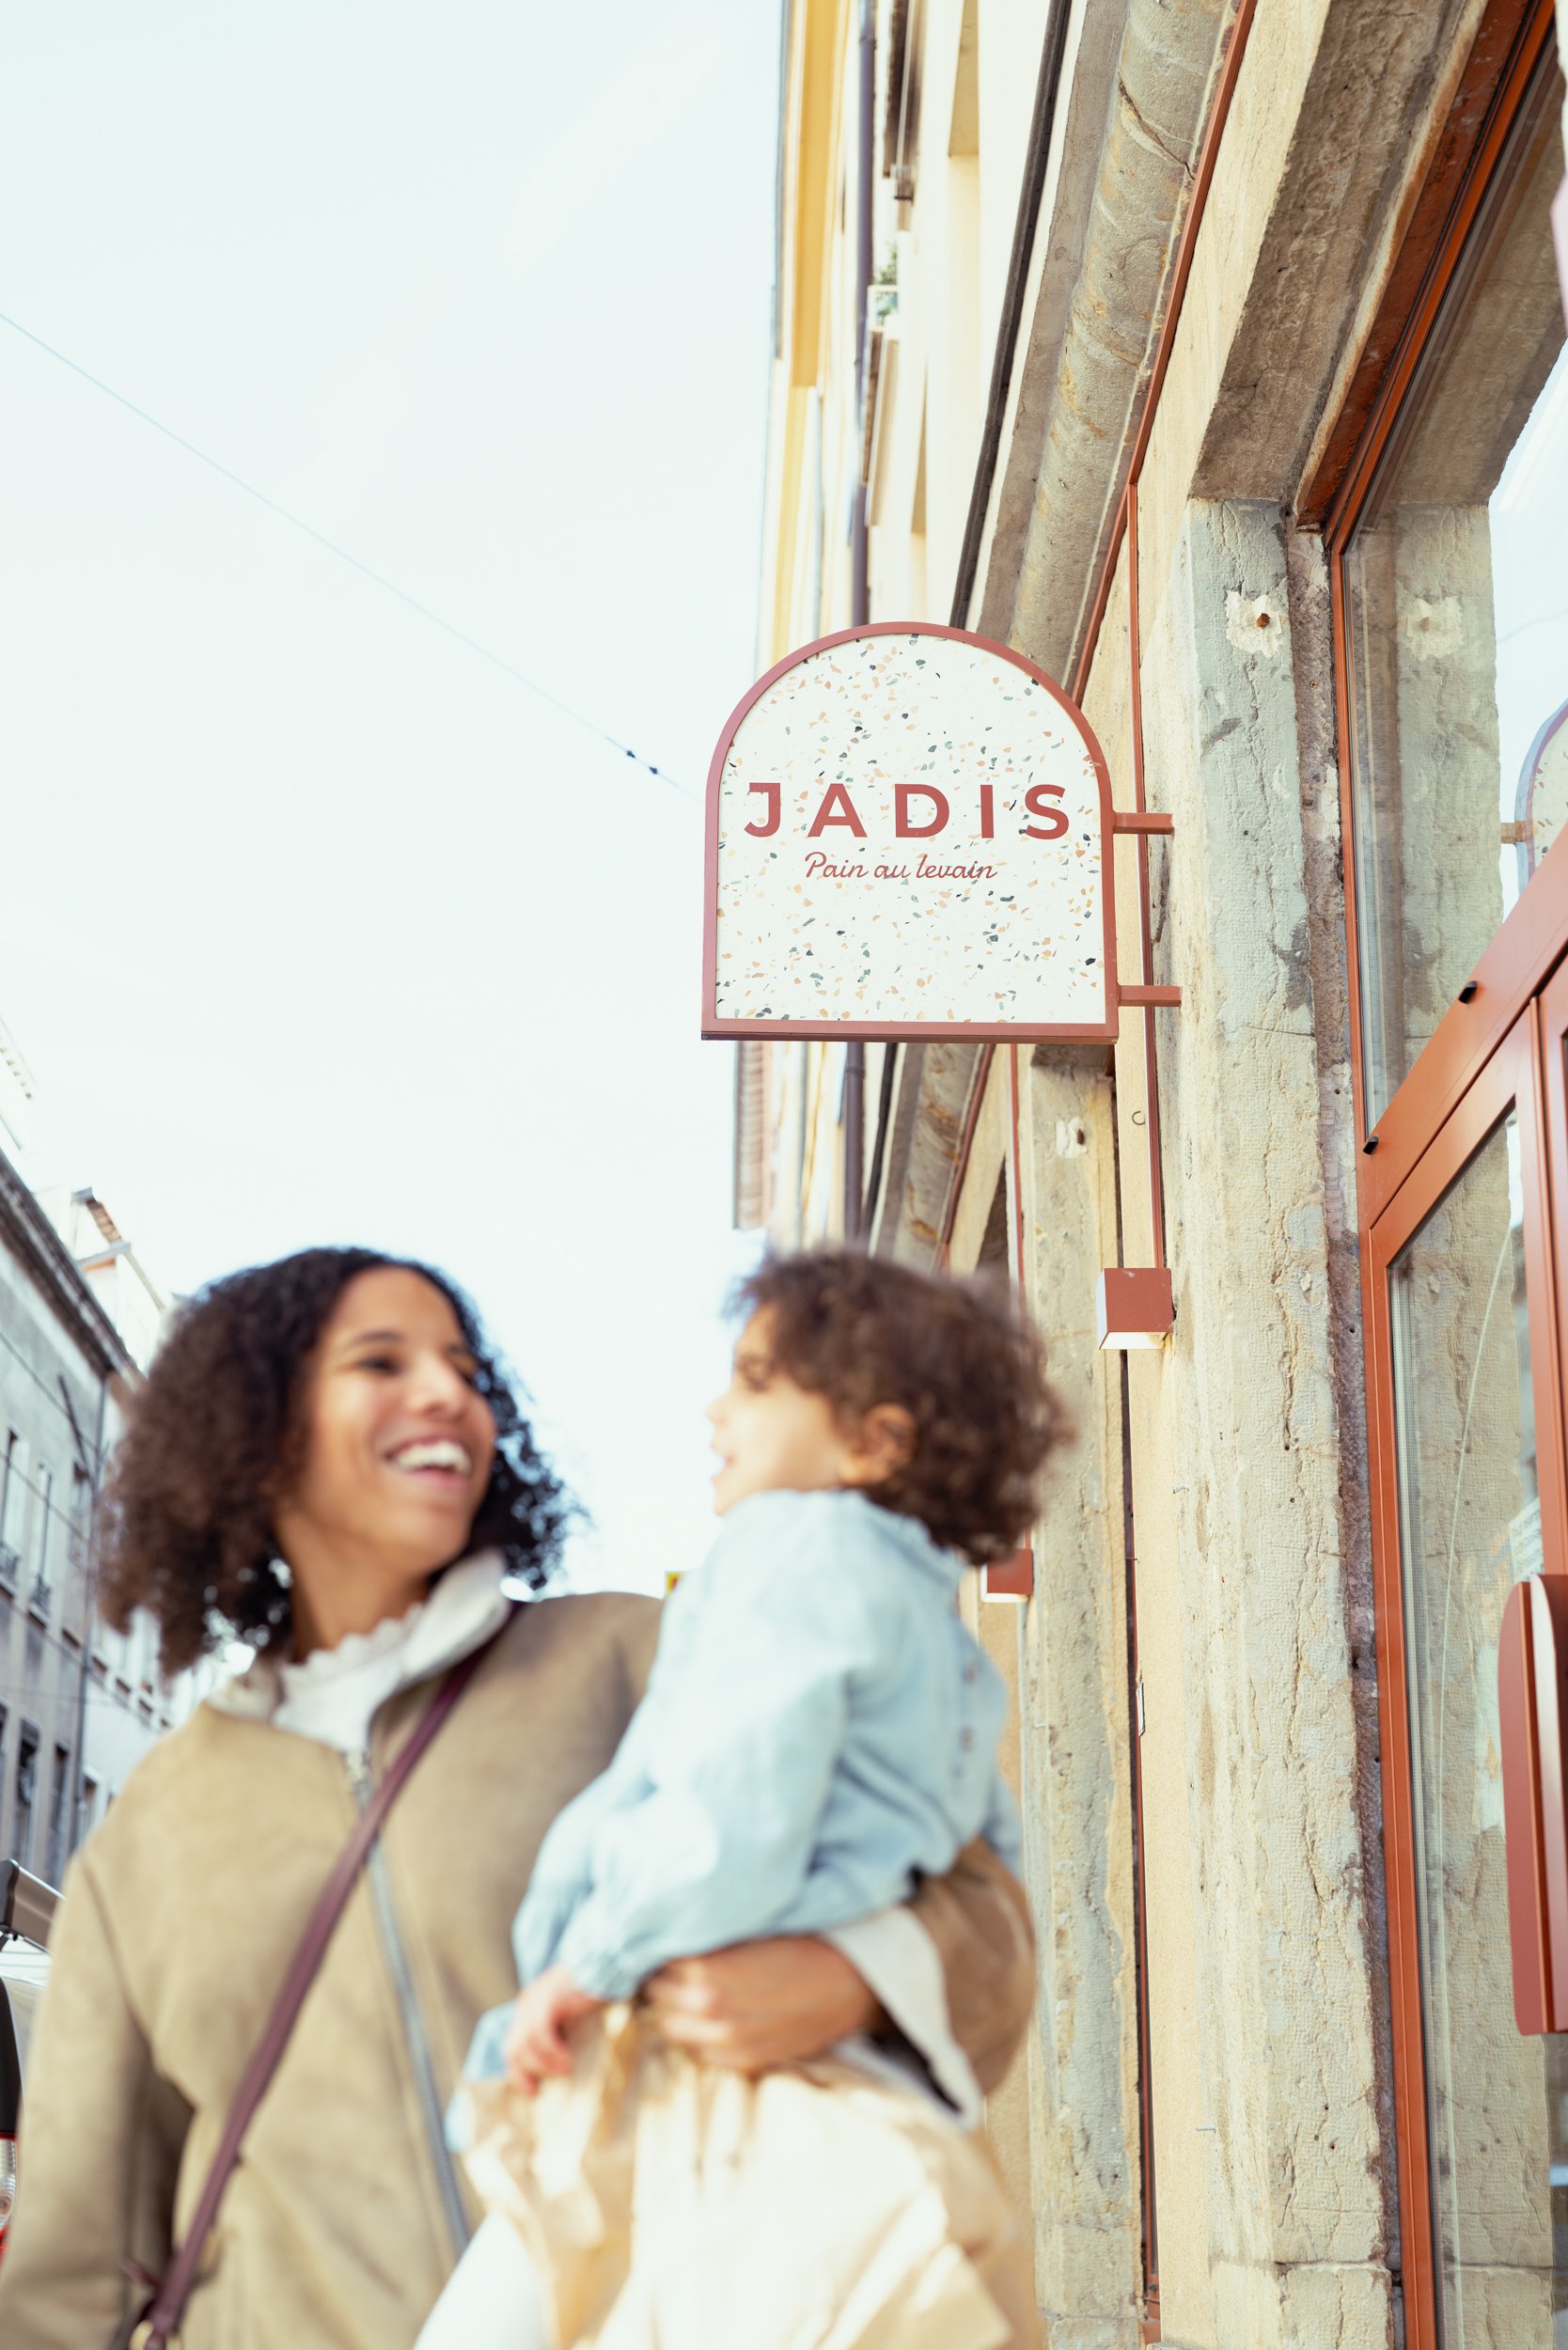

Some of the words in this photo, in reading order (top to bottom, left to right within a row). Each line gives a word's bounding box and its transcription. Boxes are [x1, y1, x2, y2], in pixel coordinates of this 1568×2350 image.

[744, 782, 1070, 839] JADIS
[805, 852, 869, 878] Pain
[873, 864, 912, 879] au
[916, 854, 998, 879] levain
